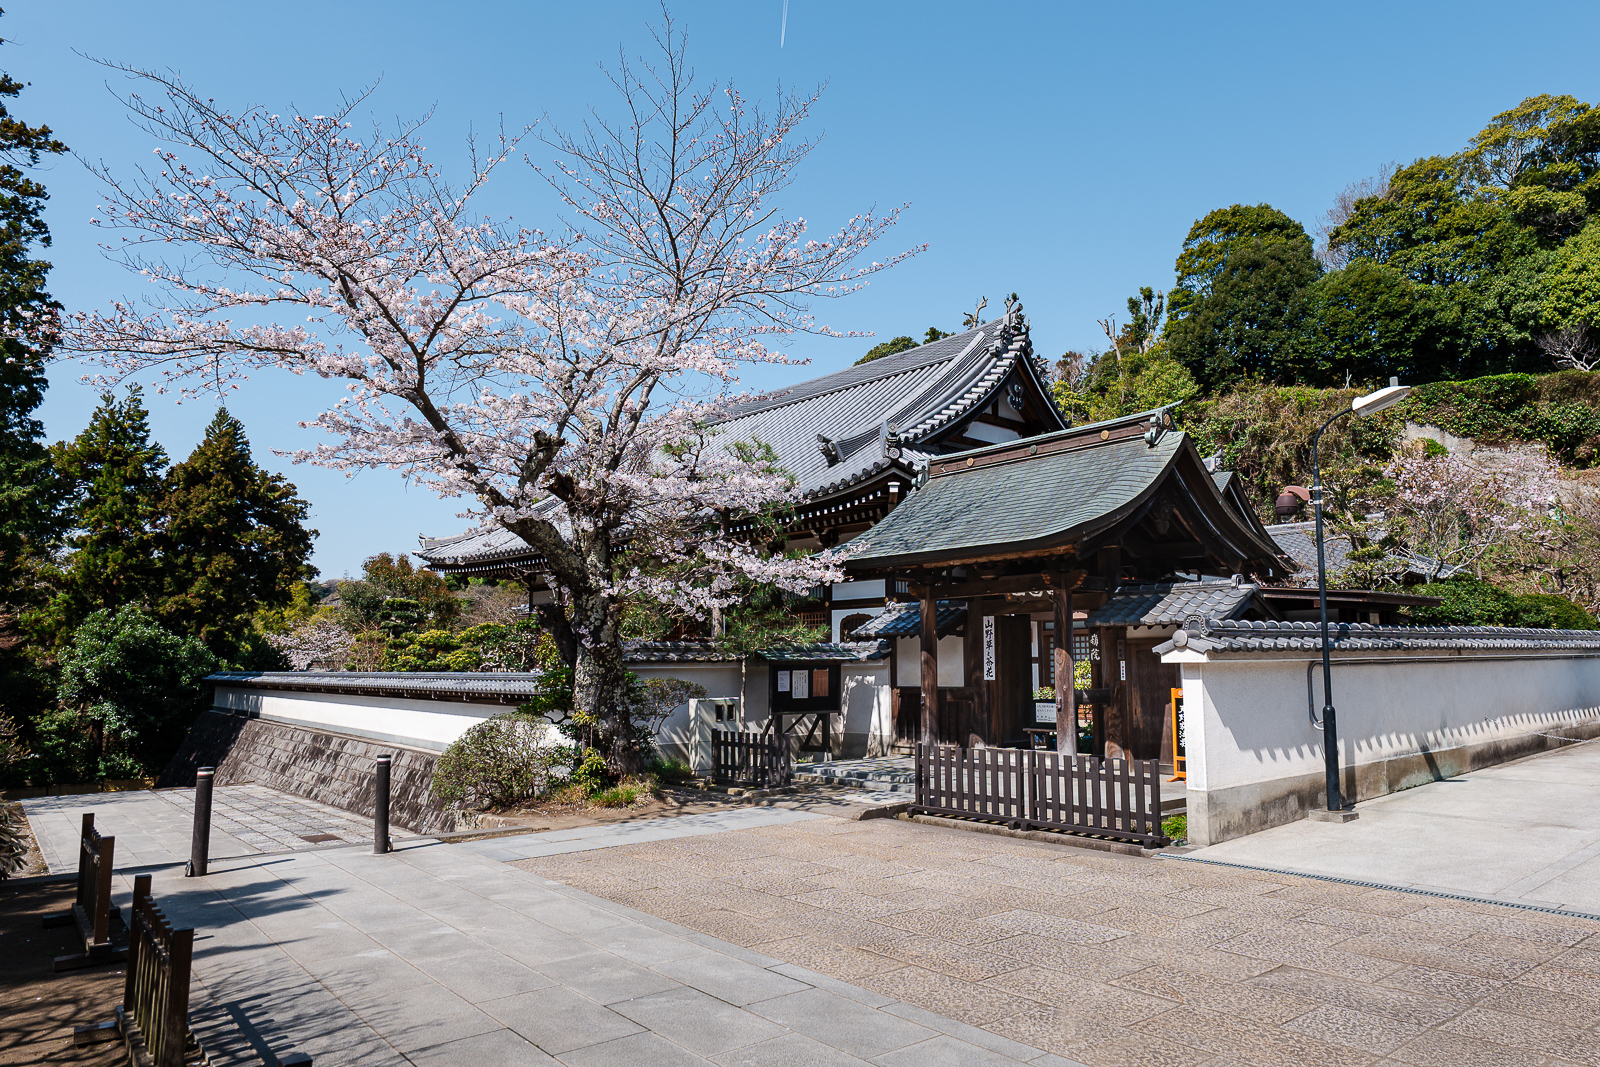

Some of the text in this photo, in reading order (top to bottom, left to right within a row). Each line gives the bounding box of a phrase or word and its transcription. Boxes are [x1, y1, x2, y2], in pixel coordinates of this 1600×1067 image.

[985, 619, 994, 678] 山野草と茶花
